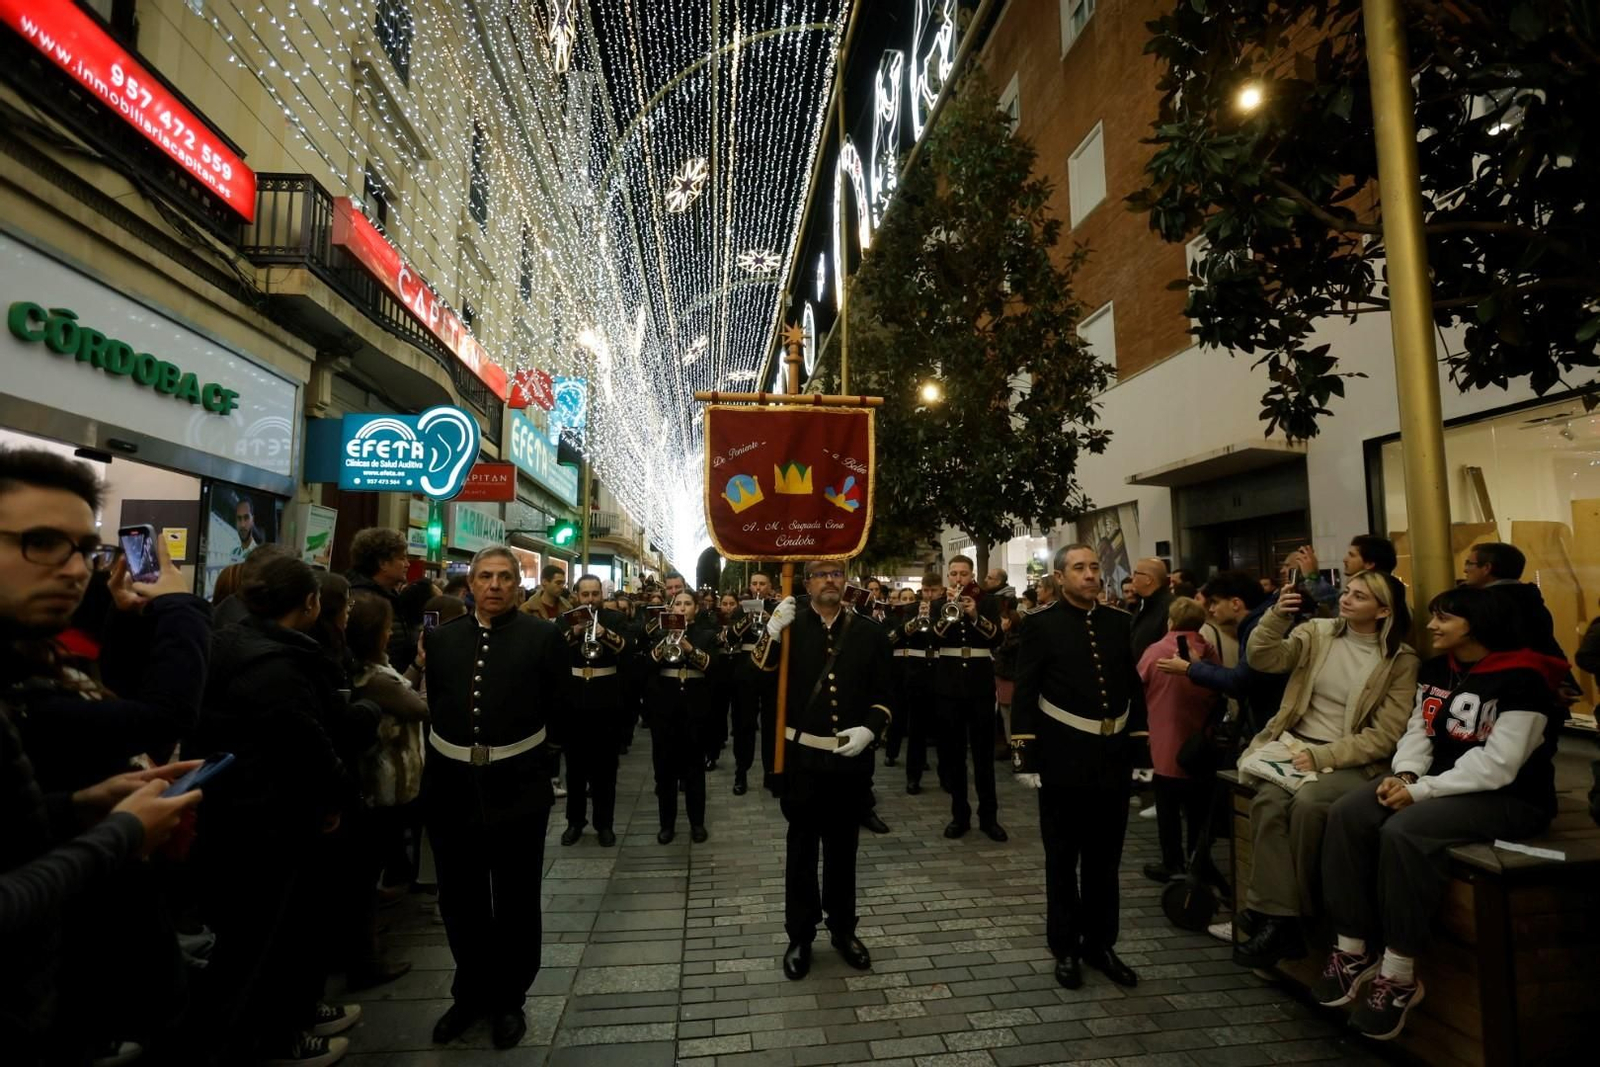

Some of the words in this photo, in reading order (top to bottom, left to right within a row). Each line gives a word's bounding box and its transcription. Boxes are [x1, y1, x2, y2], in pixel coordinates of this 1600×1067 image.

[20, 16, 232, 198] www.inmobiliariacapitan.es
[110, 63, 153, 108] 957
[159, 111, 196, 150] 472
[202, 143, 232, 181] 559
[346, 439, 424, 459] EFETA
[511, 417, 548, 478] EFETA
[371, 459, 379, 467] de
[380, 459, 397, 468] Salud
[398, 460, 424, 469] Auditiva
[713, 455, 726, 468] De
[788, 519, 821, 532] Sagrada
[825, 519, 845, 530] Cena
[775, 534, 816, 547] Córdoba
